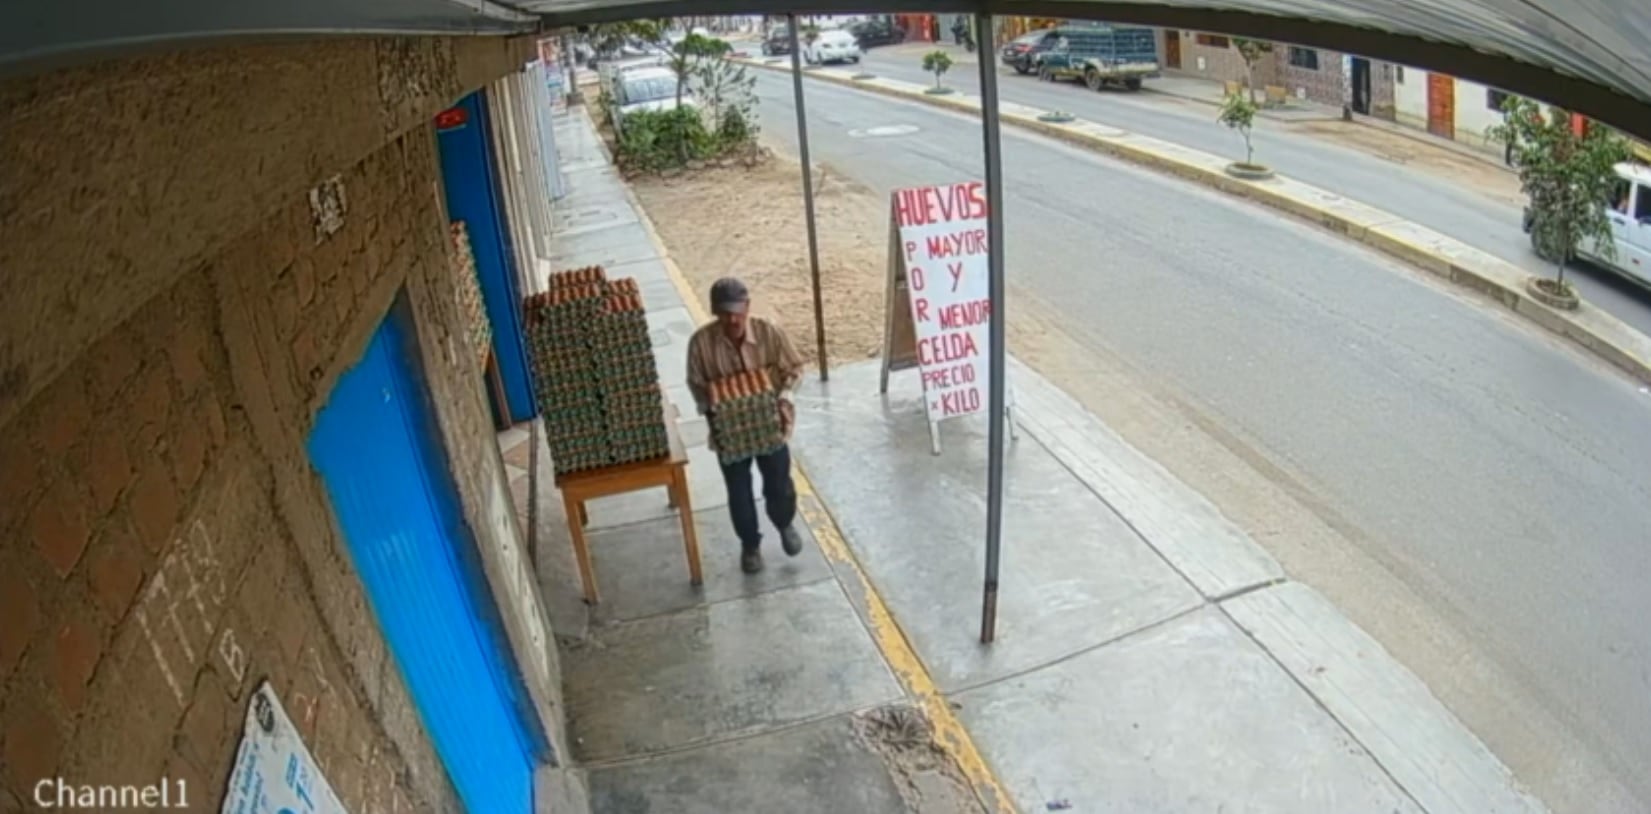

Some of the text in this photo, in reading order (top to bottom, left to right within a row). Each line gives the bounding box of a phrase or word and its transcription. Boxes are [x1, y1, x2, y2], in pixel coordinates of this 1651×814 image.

[895, 182, 988, 227] HUEVOS
[927, 229, 989, 260] MAYOR
[947, 261, 962, 292] Y
[918, 332, 978, 365] CELDA
[922, 363, 975, 392] PRECIO
[941, 388, 980, 416] KILO
